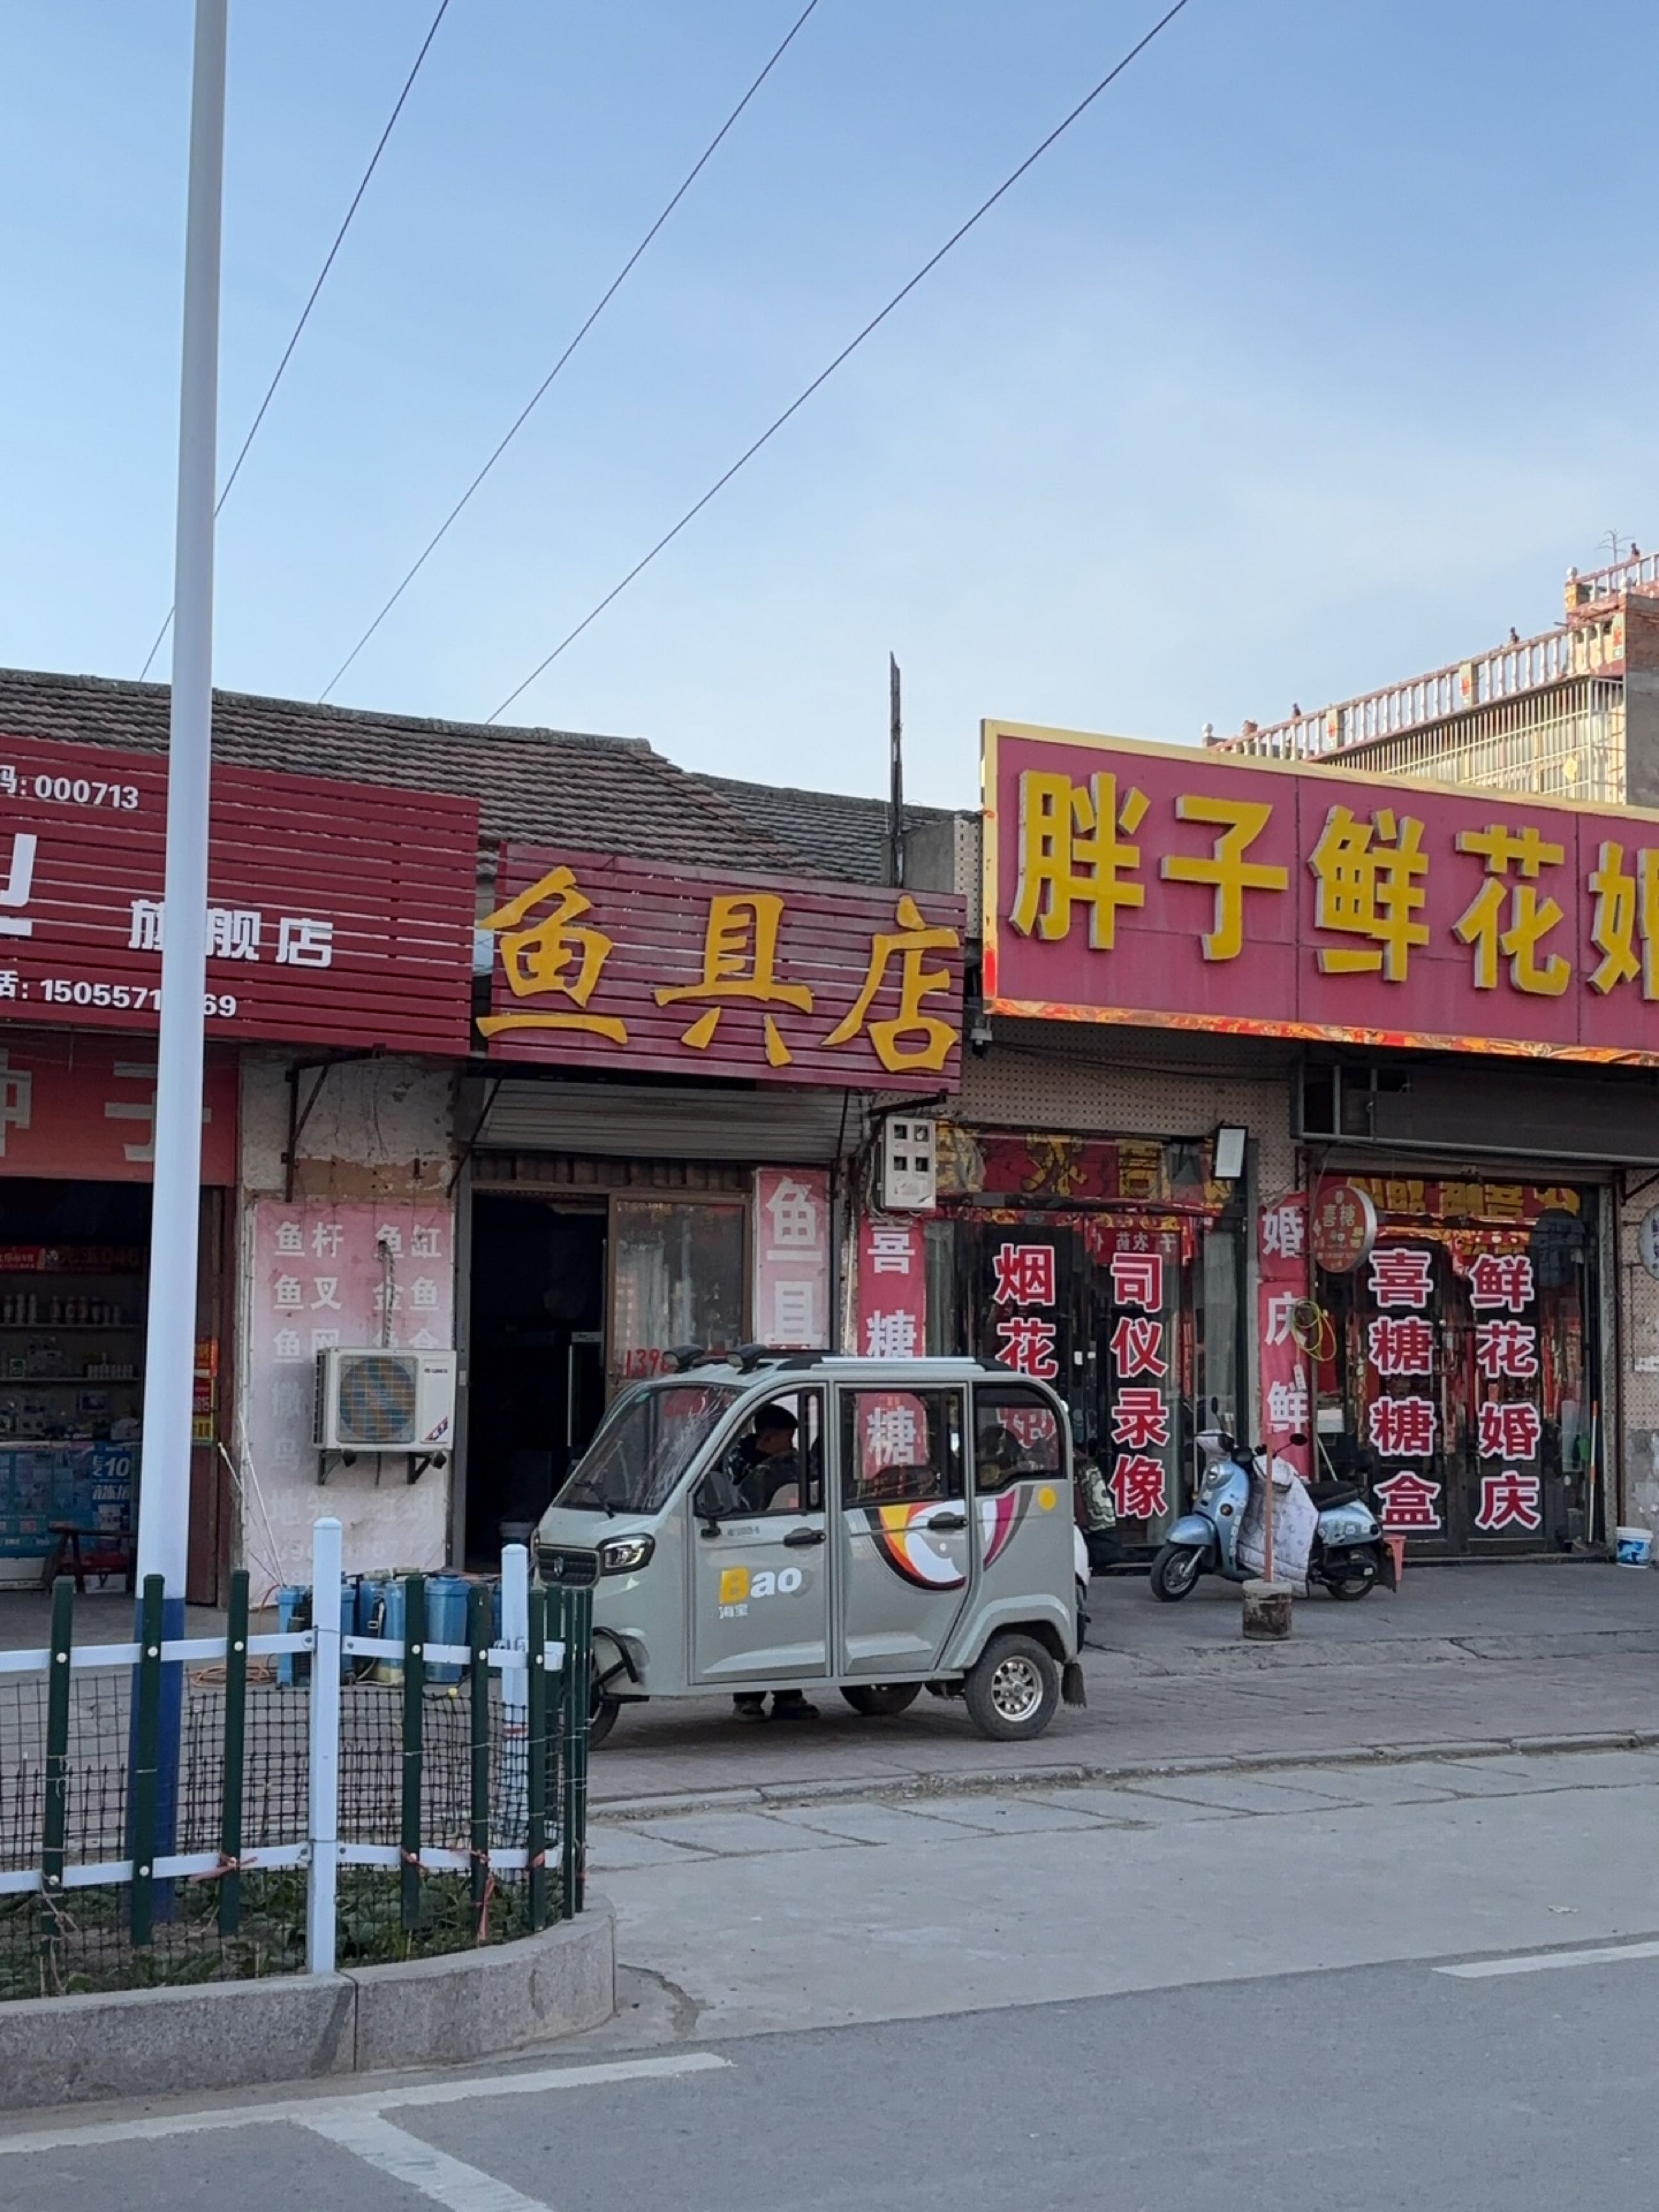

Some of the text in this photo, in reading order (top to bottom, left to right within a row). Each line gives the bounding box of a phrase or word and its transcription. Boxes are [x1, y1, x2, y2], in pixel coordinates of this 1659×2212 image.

[475, 865, 960, 1073] 鱼具店
[273, 1275, 341, 1311] 鱼叉
[274, 1221, 442, 1260] 鱼杆 鱼缸
[765, 1175, 822, 1349] 鱼具
[1110, 1251, 1169, 1521] 司仪录像
[1368, 1248, 1443, 1531] 喜糖糖盒
[1468, 1253, 1541, 1531] 鲜花婚庆
[719, 1566, 803, 1605] Bao
